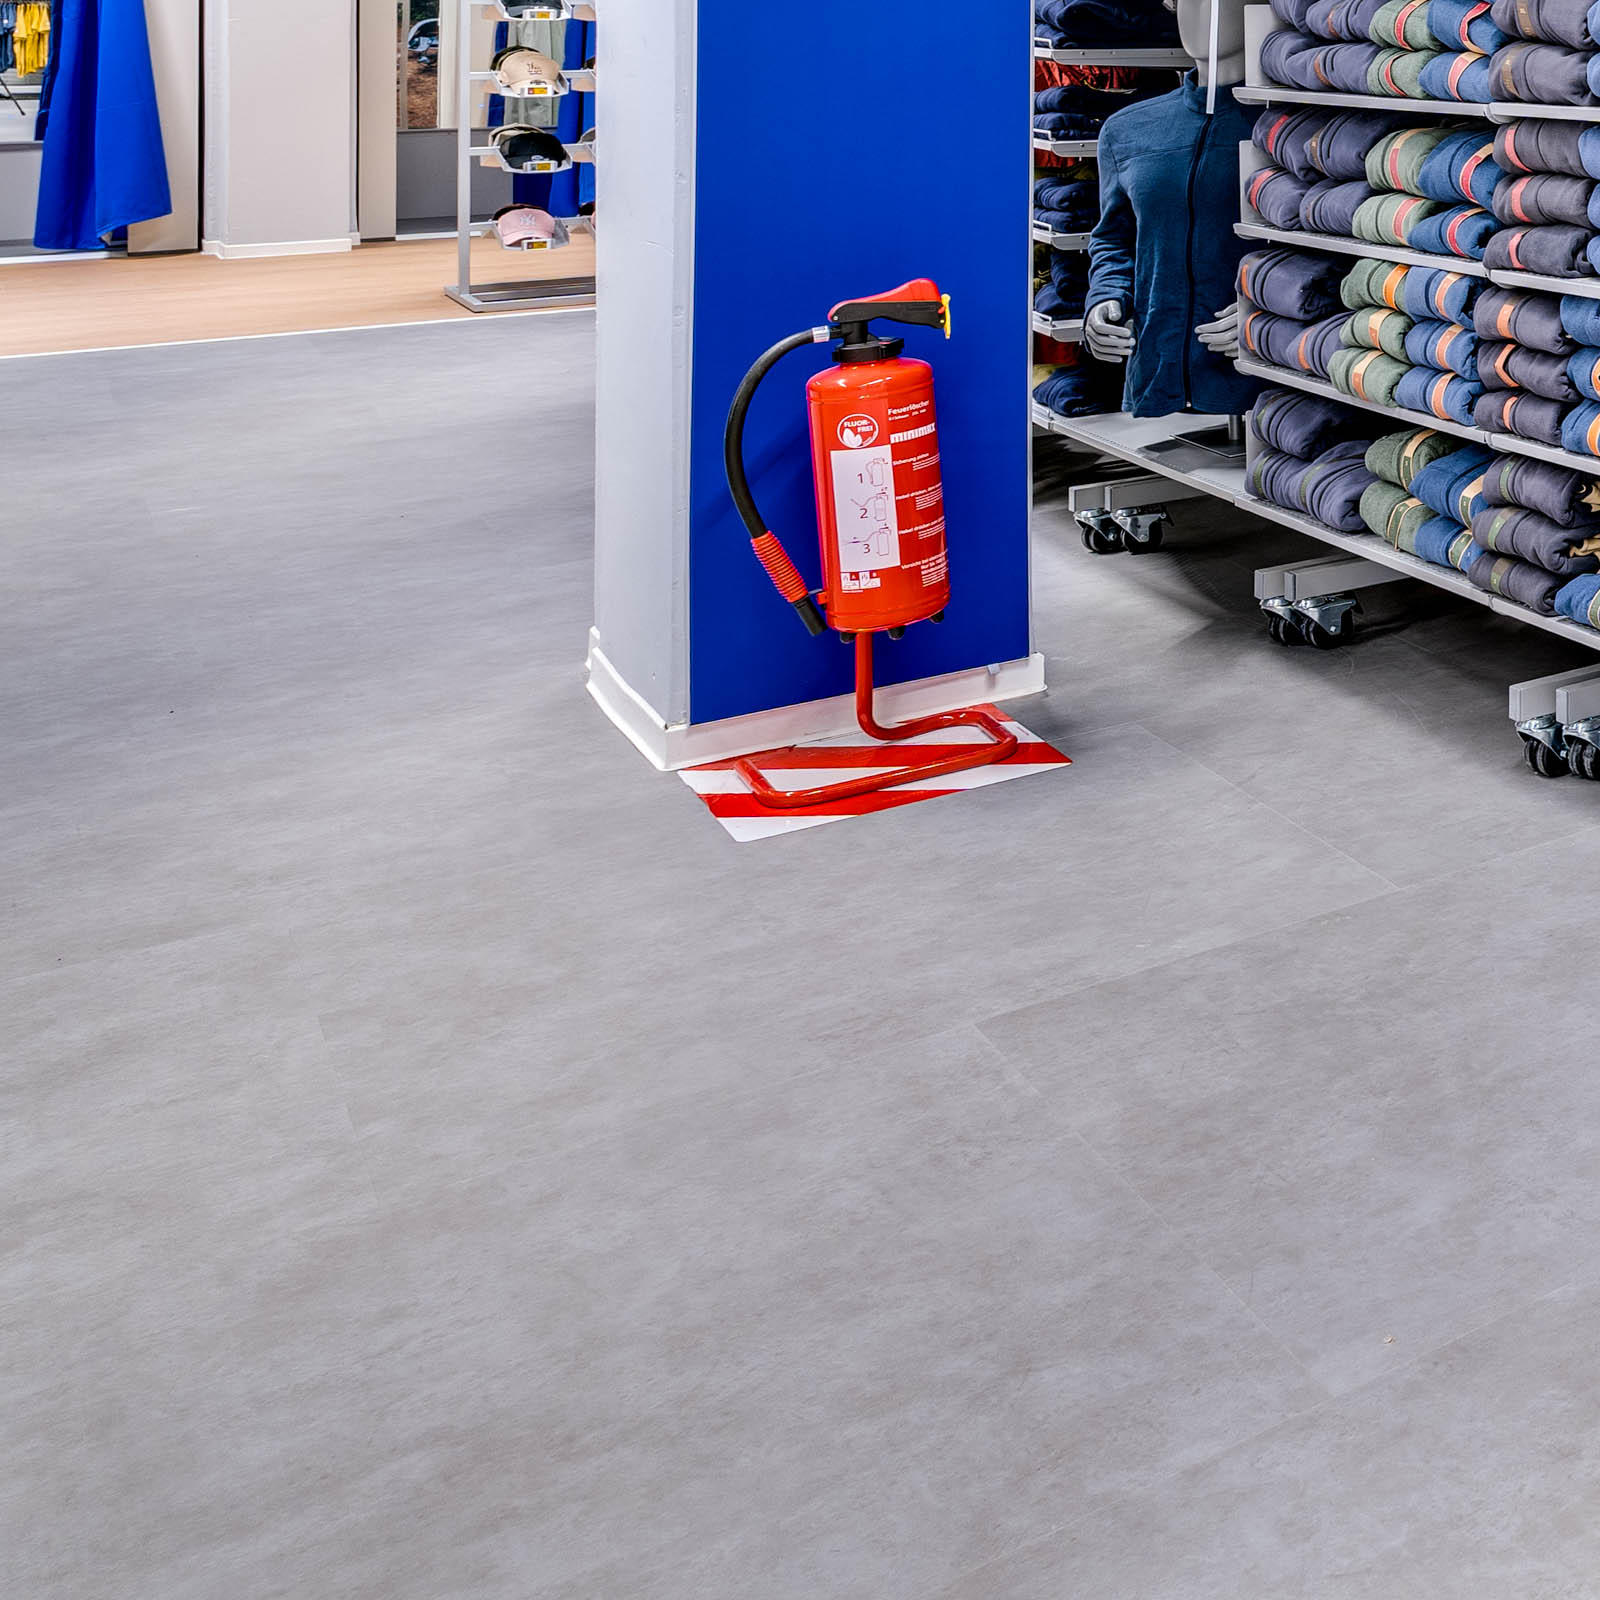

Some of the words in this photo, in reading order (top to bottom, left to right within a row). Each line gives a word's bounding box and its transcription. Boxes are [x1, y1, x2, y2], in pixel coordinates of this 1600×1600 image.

[888, 399, 930, 416] Feuerlöscher
[843, 419, 871, 428] FLUOR-
[890, 422, 936, 444] minimax
[857, 473, 863, 483] 1
[860, 508, 868, 519] 2
[863, 543, 871, 554] 3
